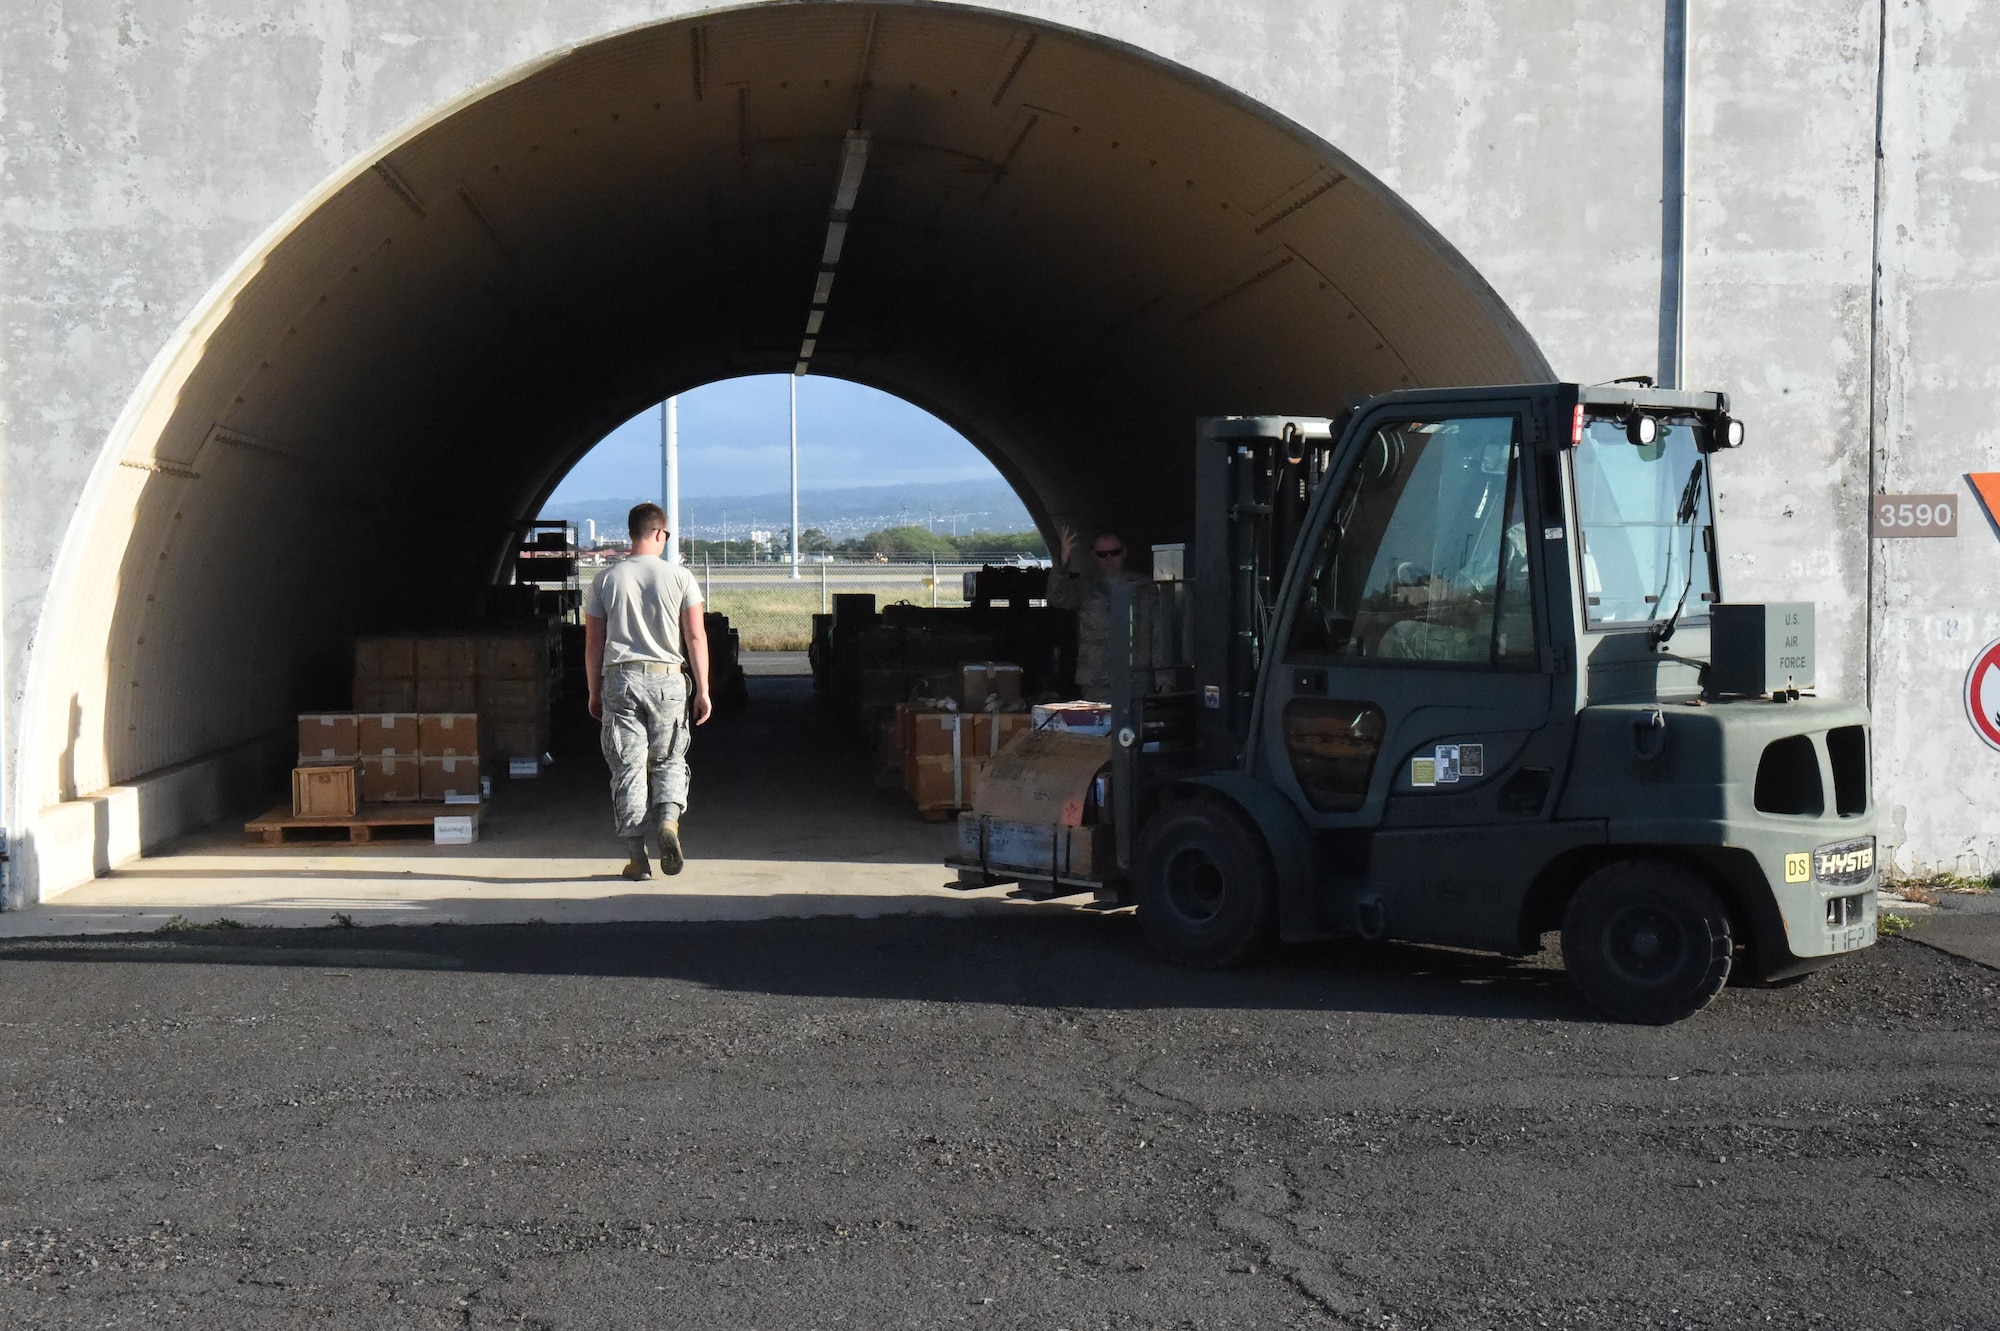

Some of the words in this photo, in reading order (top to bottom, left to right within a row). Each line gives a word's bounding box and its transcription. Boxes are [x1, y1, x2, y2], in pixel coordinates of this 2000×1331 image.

[1879, 503, 1952, 527] 3590
[1785, 613, 1800, 626] U.S.
[1785, 636, 1798, 648] AIR
[1780, 656, 1806, 669] FORCE
[1788, 859, 1806, 876] DS
[1820, 847, 1873, 875] HYSTER
